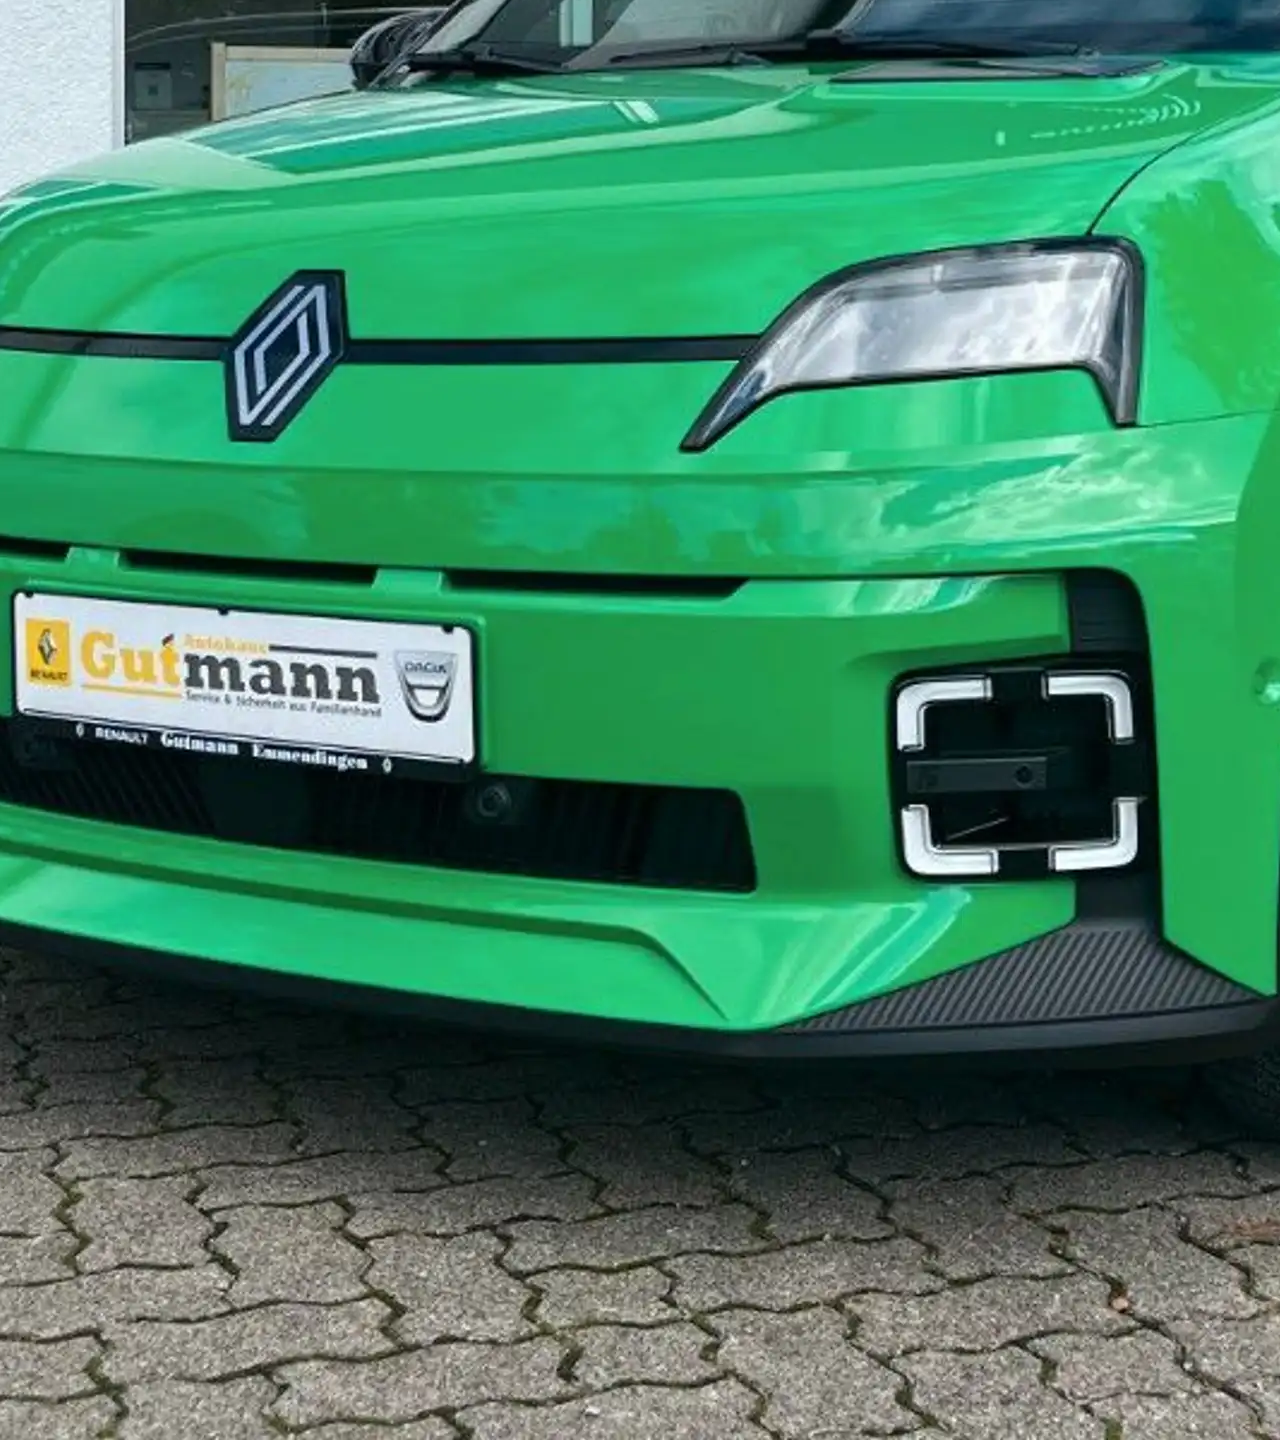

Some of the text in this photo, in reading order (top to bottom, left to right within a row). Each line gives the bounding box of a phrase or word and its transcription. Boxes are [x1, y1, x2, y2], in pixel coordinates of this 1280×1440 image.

[80, 631, 380, 705] Gutmann
[94, 727, 369, 772] RENAULT Gutmann Emmendingen
